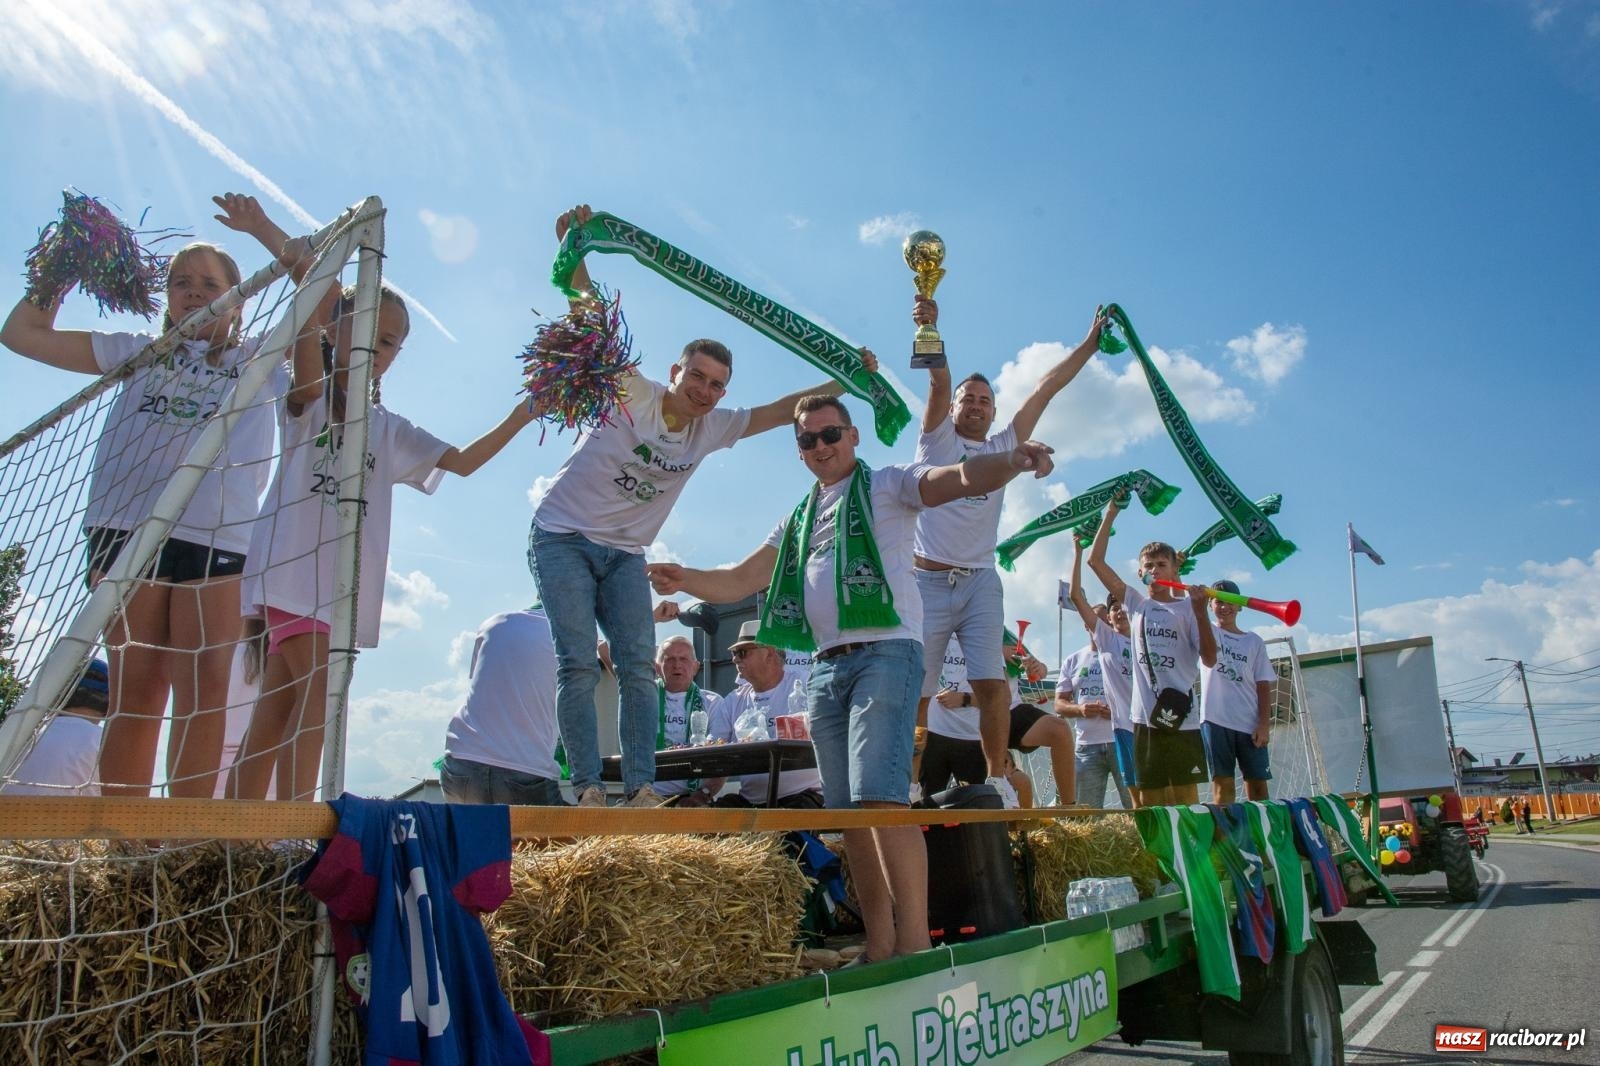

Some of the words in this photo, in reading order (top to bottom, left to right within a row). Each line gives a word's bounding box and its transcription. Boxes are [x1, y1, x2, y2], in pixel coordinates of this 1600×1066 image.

[604, 219, 662, 261] KS
[663, 245, 863, 379] PIETRASZYN
[1146, 627, 1178, 640] KLASA
[1160, 655, 1175, 669] 23
[912, 967, 1109, 1066] Pietraszyna
